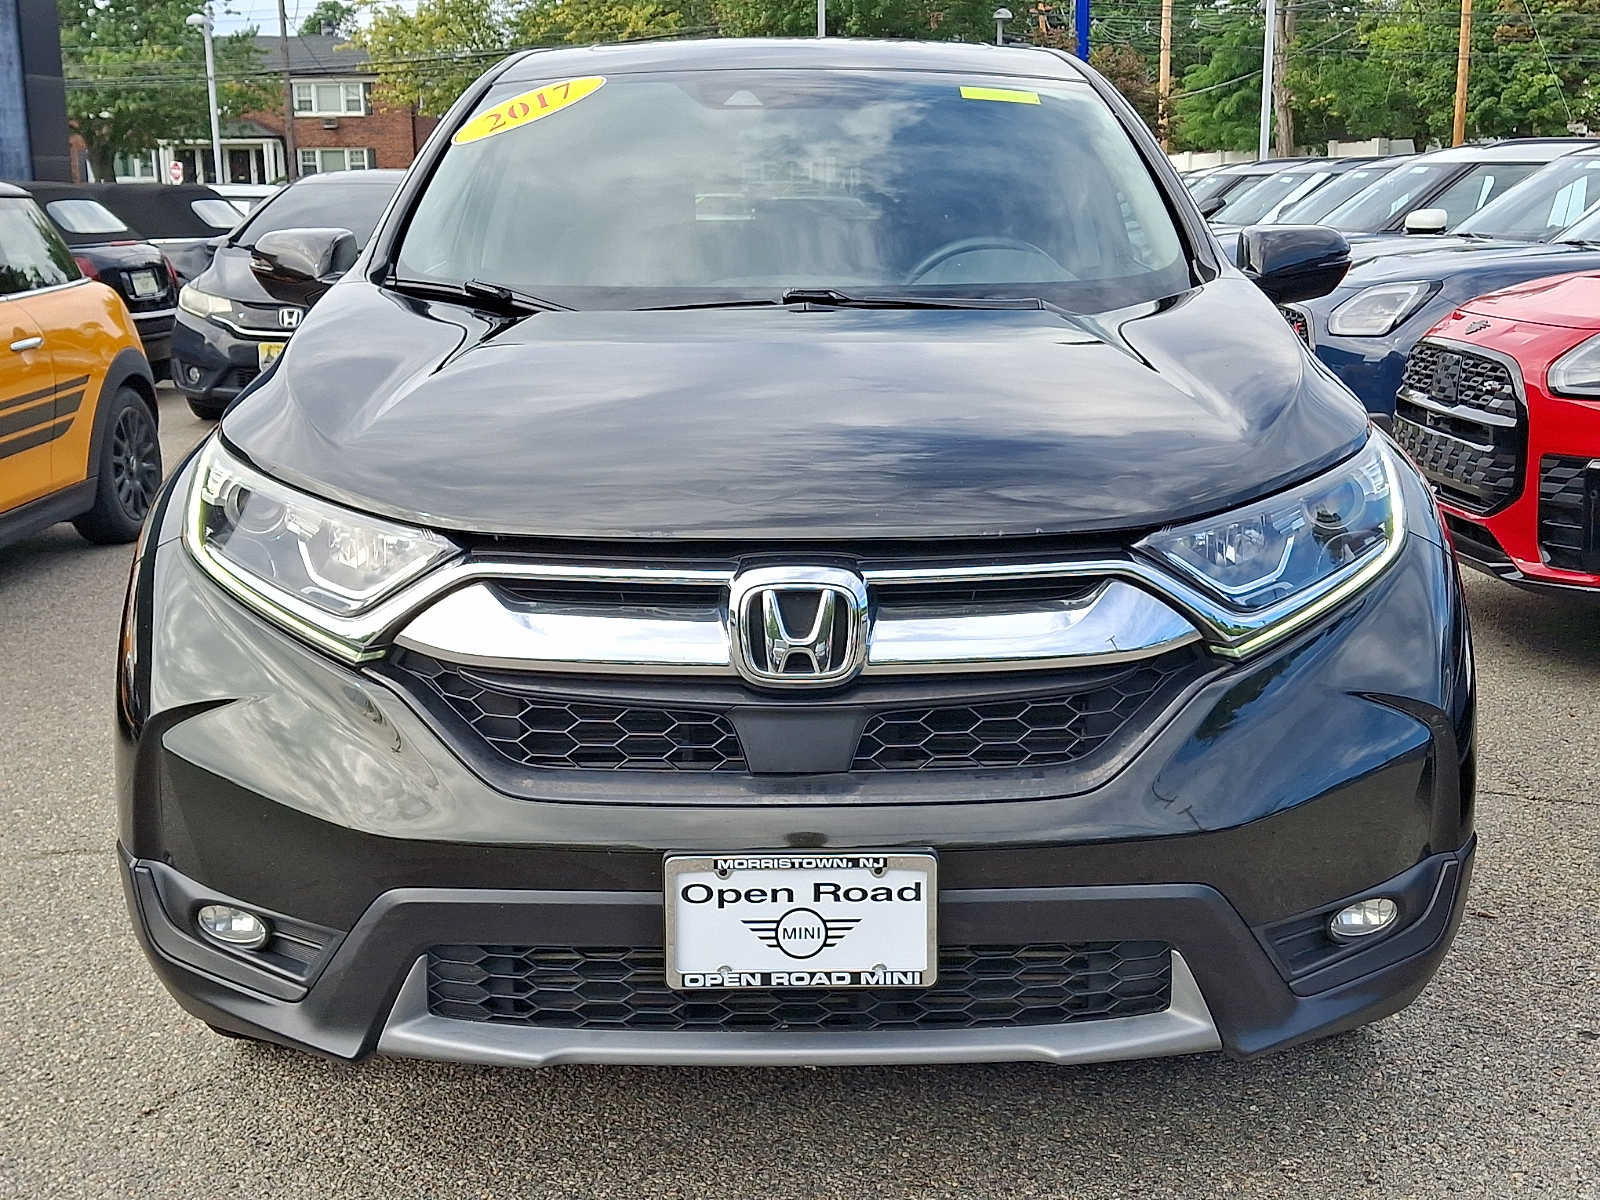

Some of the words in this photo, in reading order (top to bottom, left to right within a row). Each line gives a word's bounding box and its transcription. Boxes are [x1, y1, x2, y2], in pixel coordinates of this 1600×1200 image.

[486, 82, 570, 132] 2017
[859, 857, 885, 868] NJ
[681, 883, 794, 909] Open
[813, 882, 922, 903] Road
[782, 927, 821, 940] MINI
[684, 972, 761, 987] OPEN
[771, 972, 850, 986] ROAD
[861, 971, 921, 986] MINI
